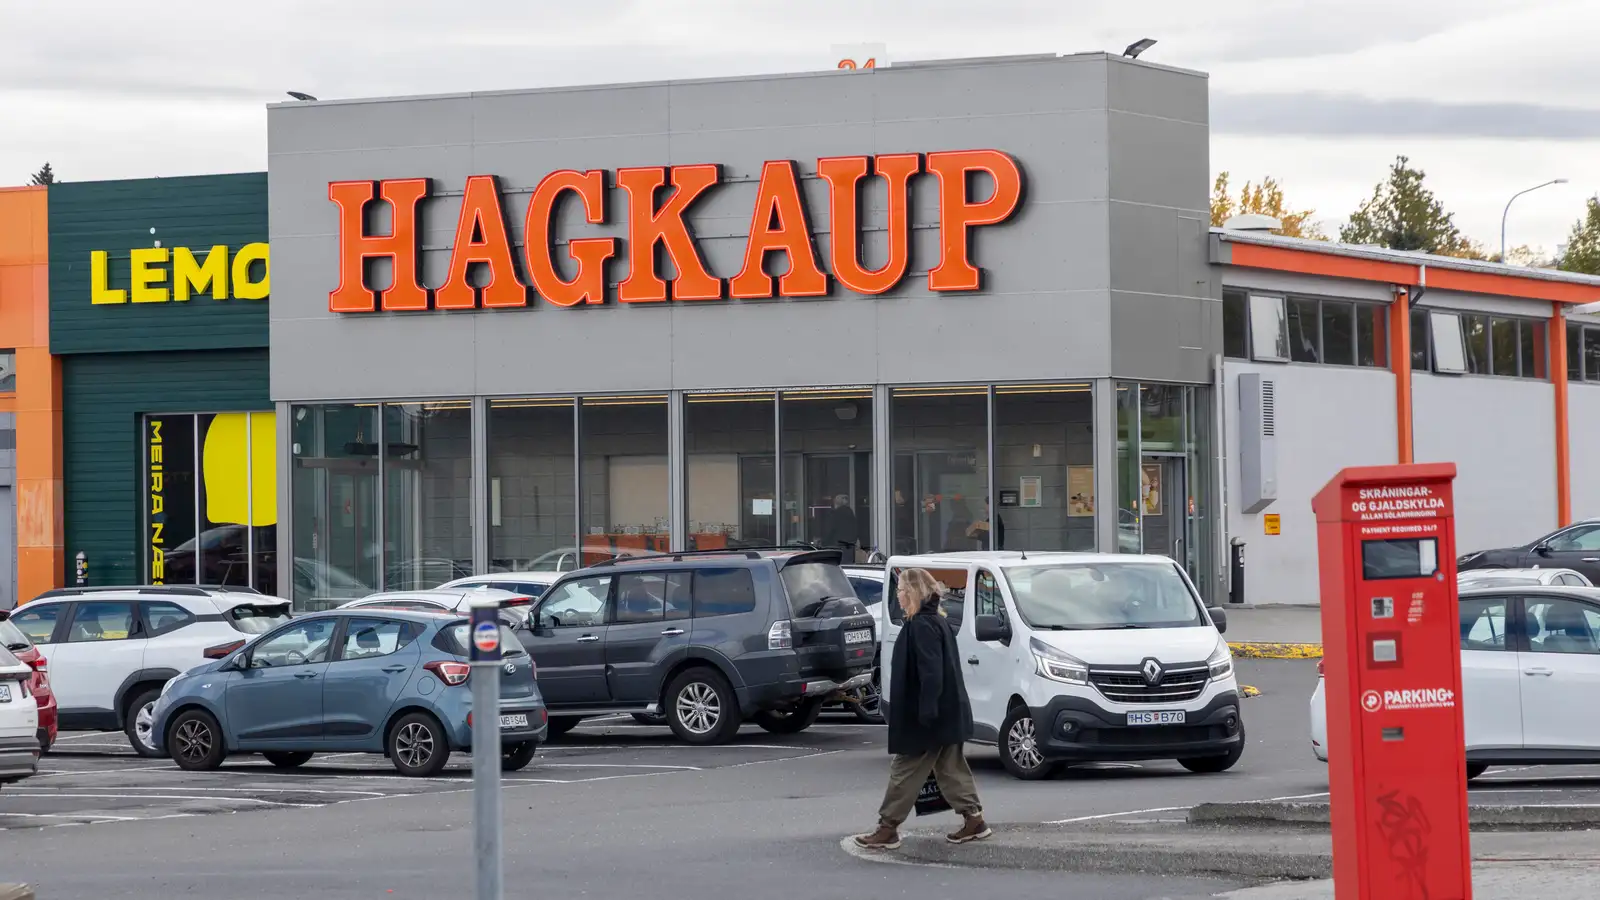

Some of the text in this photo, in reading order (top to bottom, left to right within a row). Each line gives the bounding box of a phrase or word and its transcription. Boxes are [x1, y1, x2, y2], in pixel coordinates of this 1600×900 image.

[328, 149, 1023, 313] HAGKAUP
[91, 242, 269, 304] LEMO
[1359, 486, 1433, 500] SKRÁNINGAR-
[150, 421, 164, 586] MEIRA NÆ
[1352, 498, 1444, 512] OG GJALDSKYLDA
[1361, 512, 1384, 520] ALLAN
[1361, 525, 1391, 534] PAYMENT
[1391, 524, 1422, 533] REQUIRED
[1134, 713, 1152, 723] HS
[1161, 712, 1184, 722] B70
